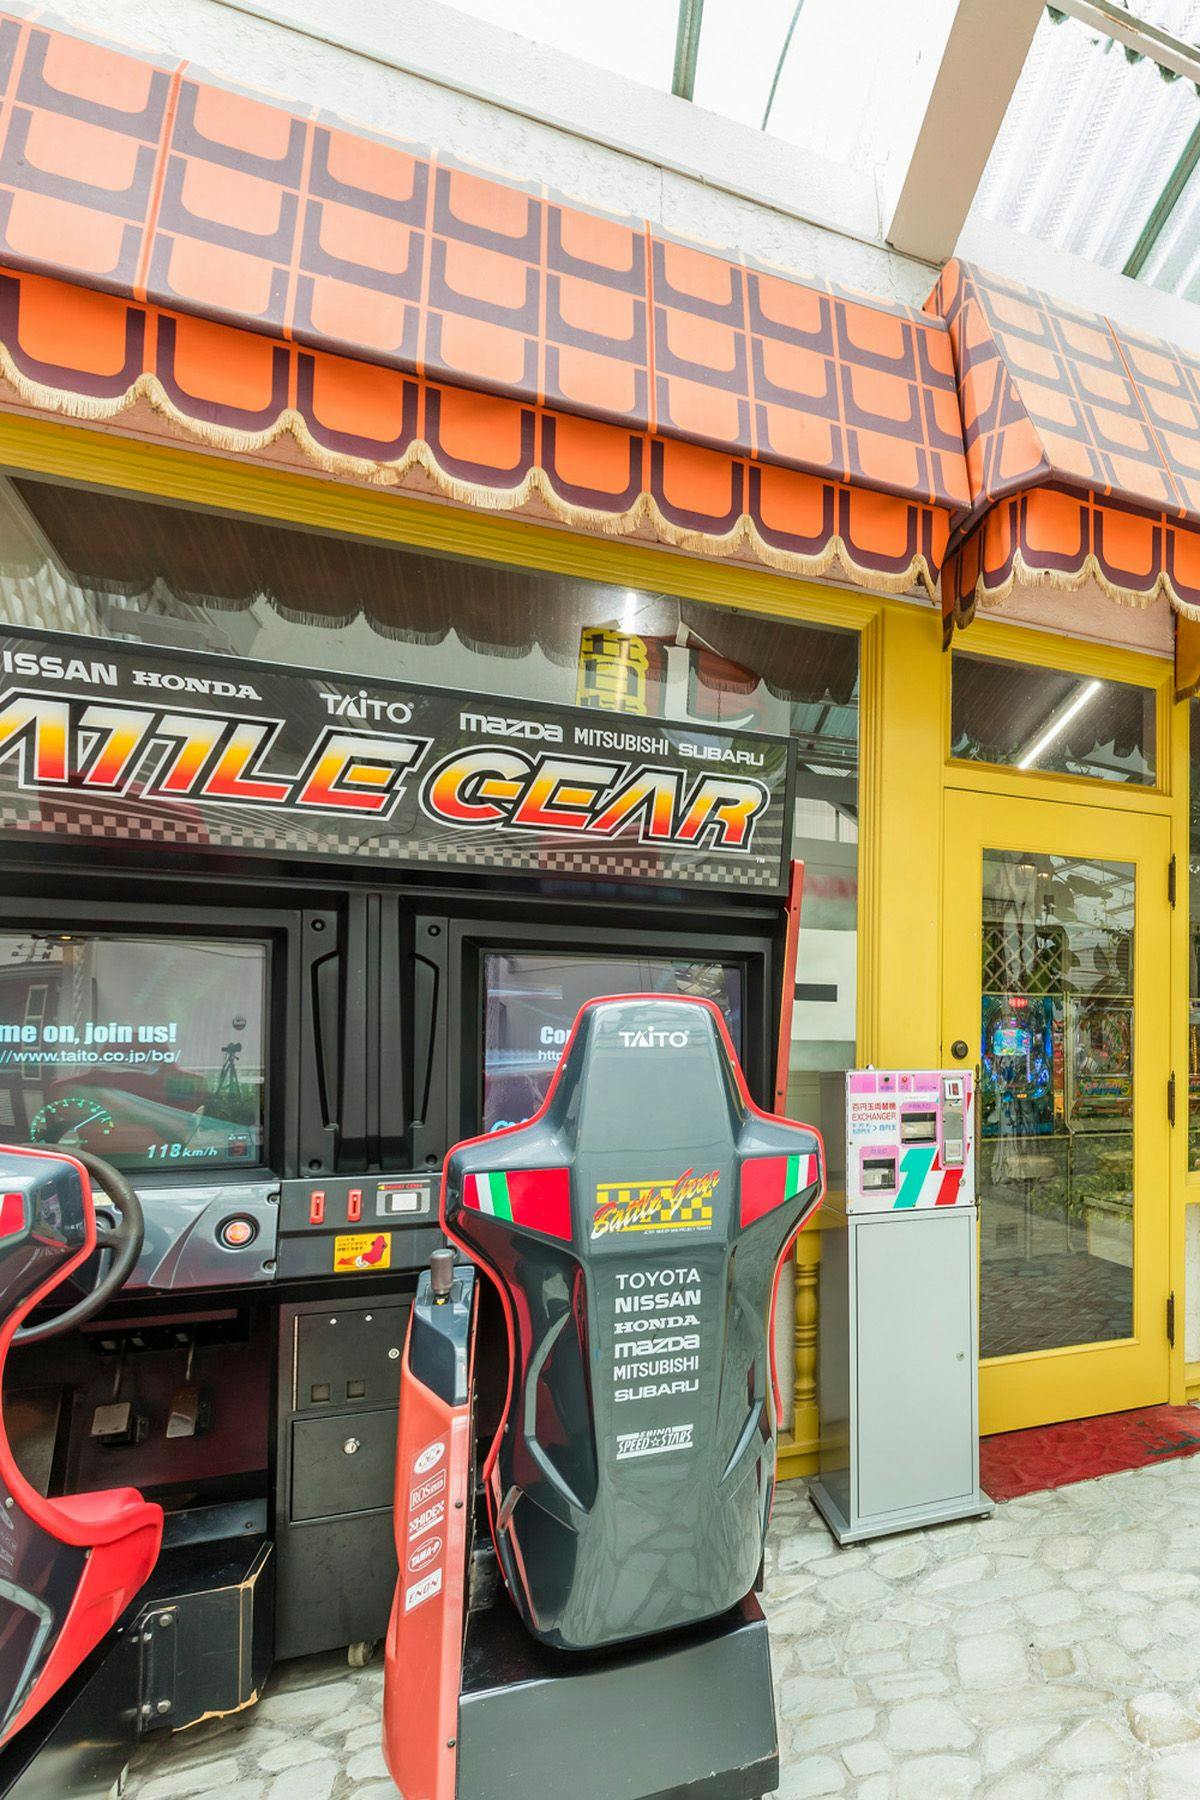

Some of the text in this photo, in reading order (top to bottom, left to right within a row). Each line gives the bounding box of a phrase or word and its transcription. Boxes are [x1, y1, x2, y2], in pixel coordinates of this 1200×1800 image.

[3, 651, 262, 701] ISSAN HONDA
[574, 727, 669, 756] MITSUBISHI
[678, 743, 764, 767] SUBARU
[421, 746, 769, 851] GEAR
[43, 1024, 80, 1045] on,
[84, 1022, 132, 1045] join
[138, 1023, 177, 1043] us!
[851, 1112, 897, 1122] EXCHANGER
[615, 1268, 701, 1290] TOYOTA
[615, 1289, 702, 1314] NISSAN
[614, 1314, 701, 1335] HONDA
[613, 1355, 699, 1381] MITSUBISHI
[614, 1378, 700, 1402] SUBARU
[618, 1429, 693, 1454] SPEED STARS
